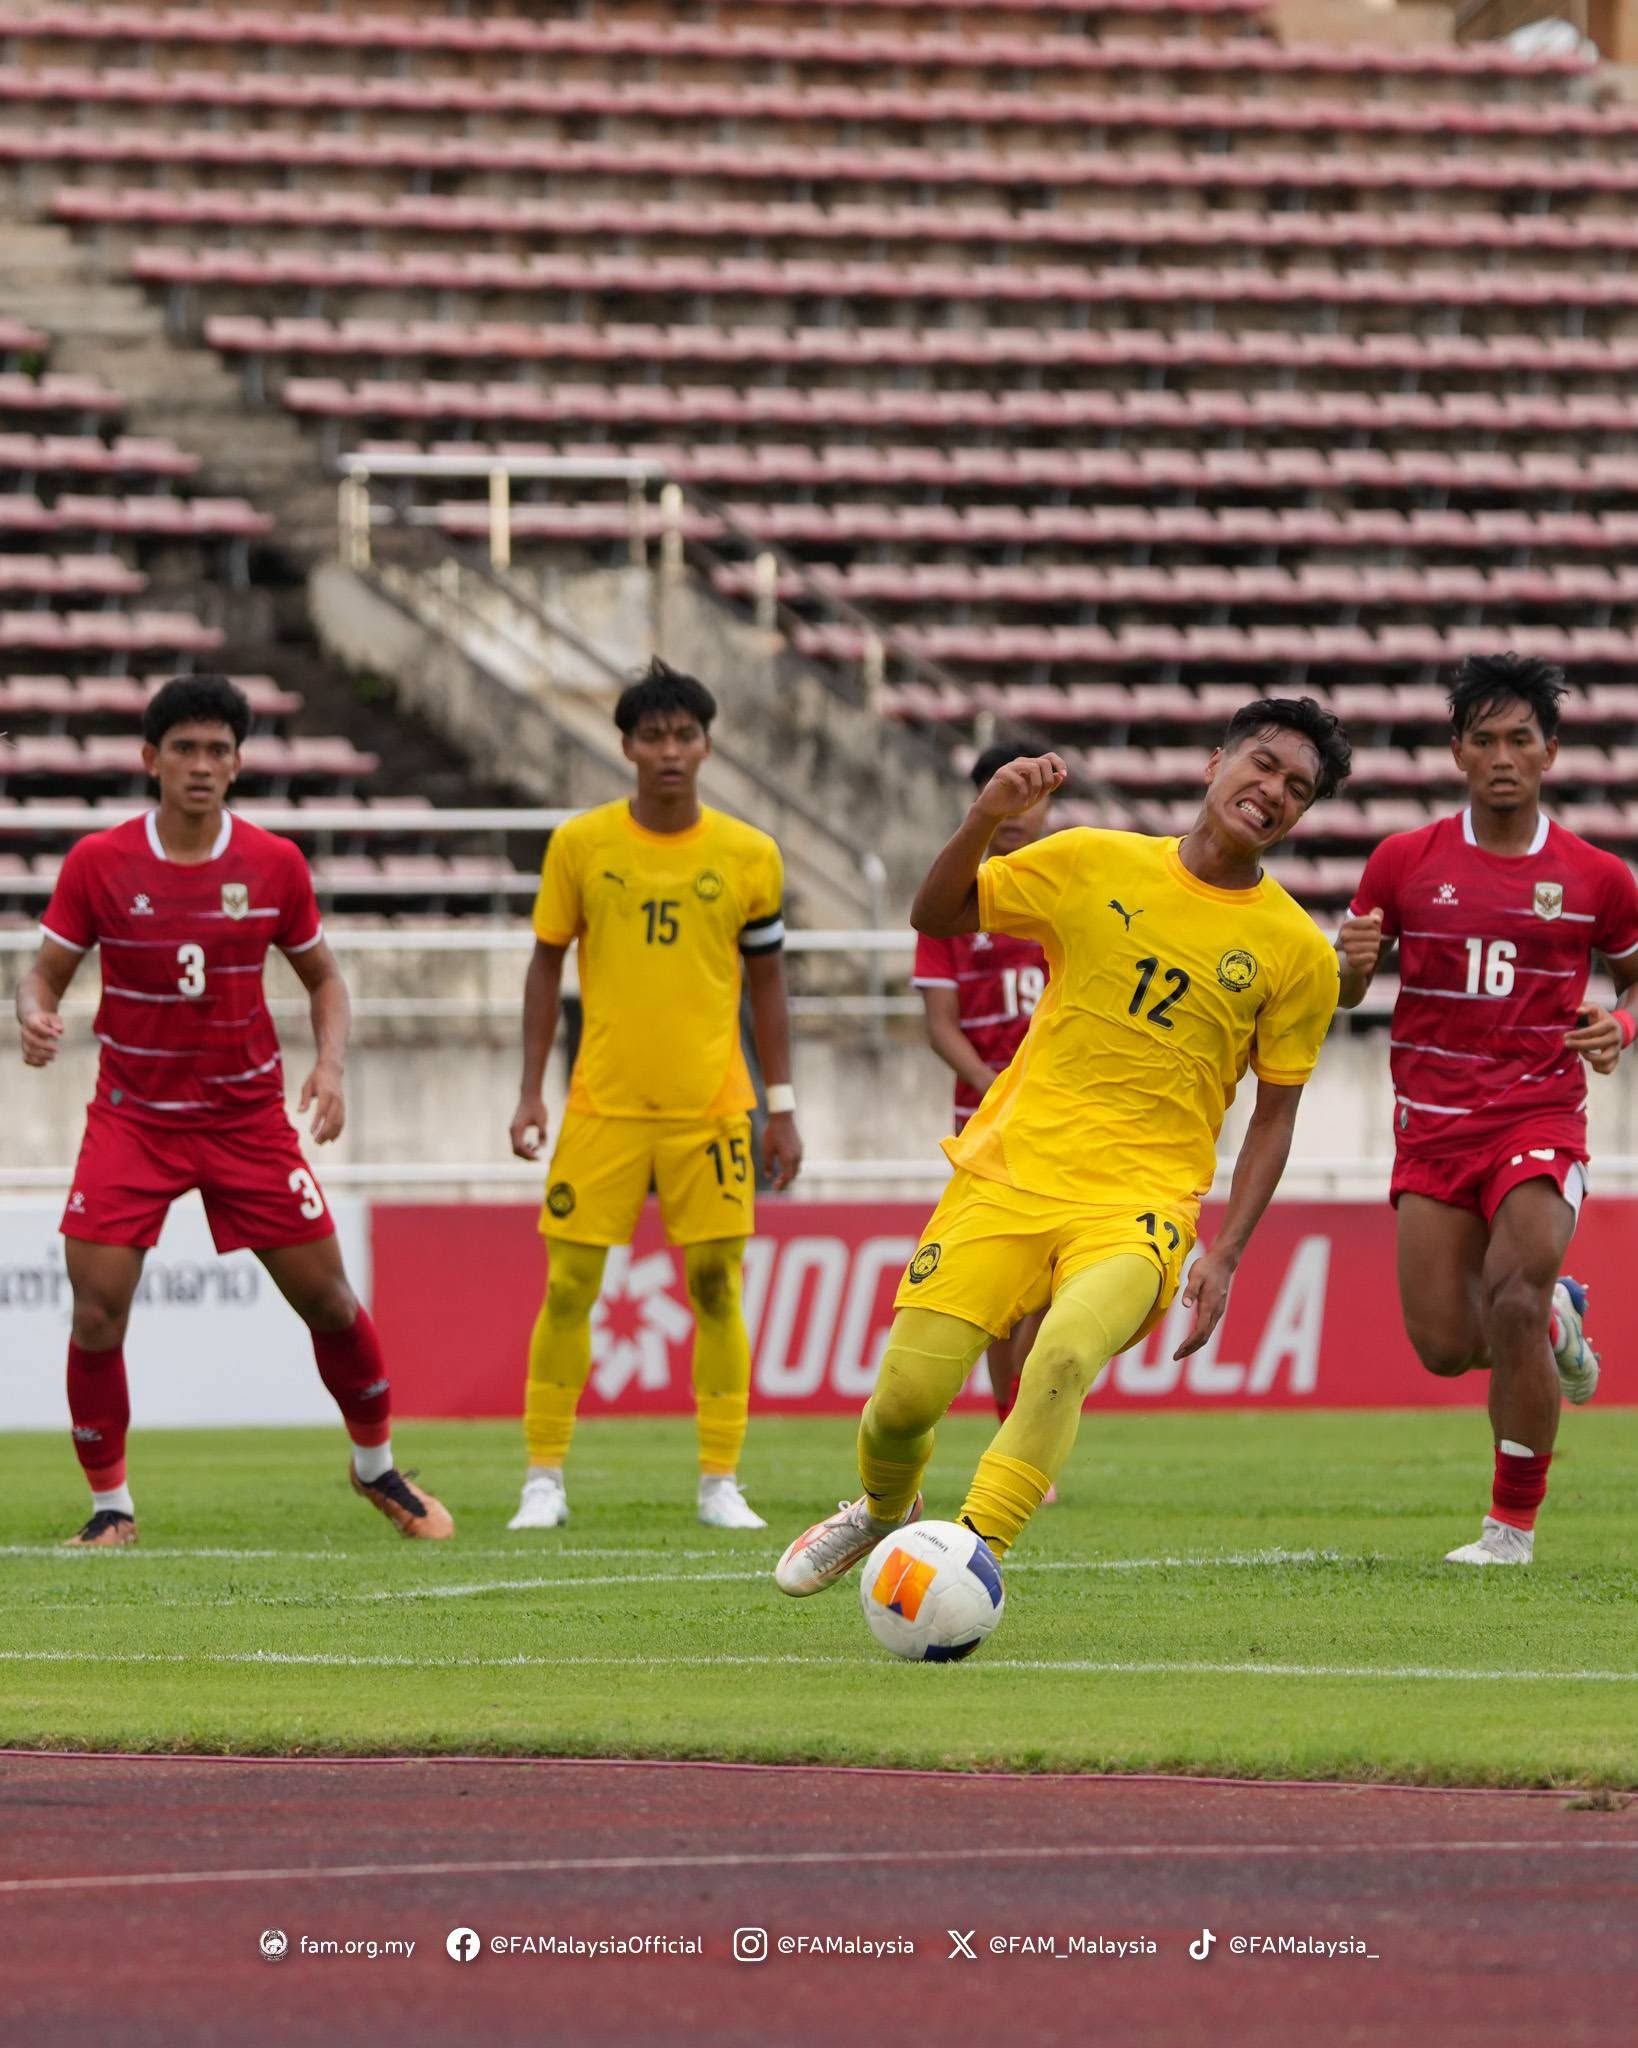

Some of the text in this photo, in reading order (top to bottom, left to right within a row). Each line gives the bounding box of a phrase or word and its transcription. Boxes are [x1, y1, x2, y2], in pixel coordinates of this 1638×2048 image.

[641, 900, 681, 945] 15
[176, 943, 206, 996] 3
[1001, 967, 1046, 1017] 19
[1127, 957, 1191, 1029] 12
[1464, 938, 1518, 998] 16
[705, 1138, 748, 1186] 15
[287, 1167, 325, 1220] 3
